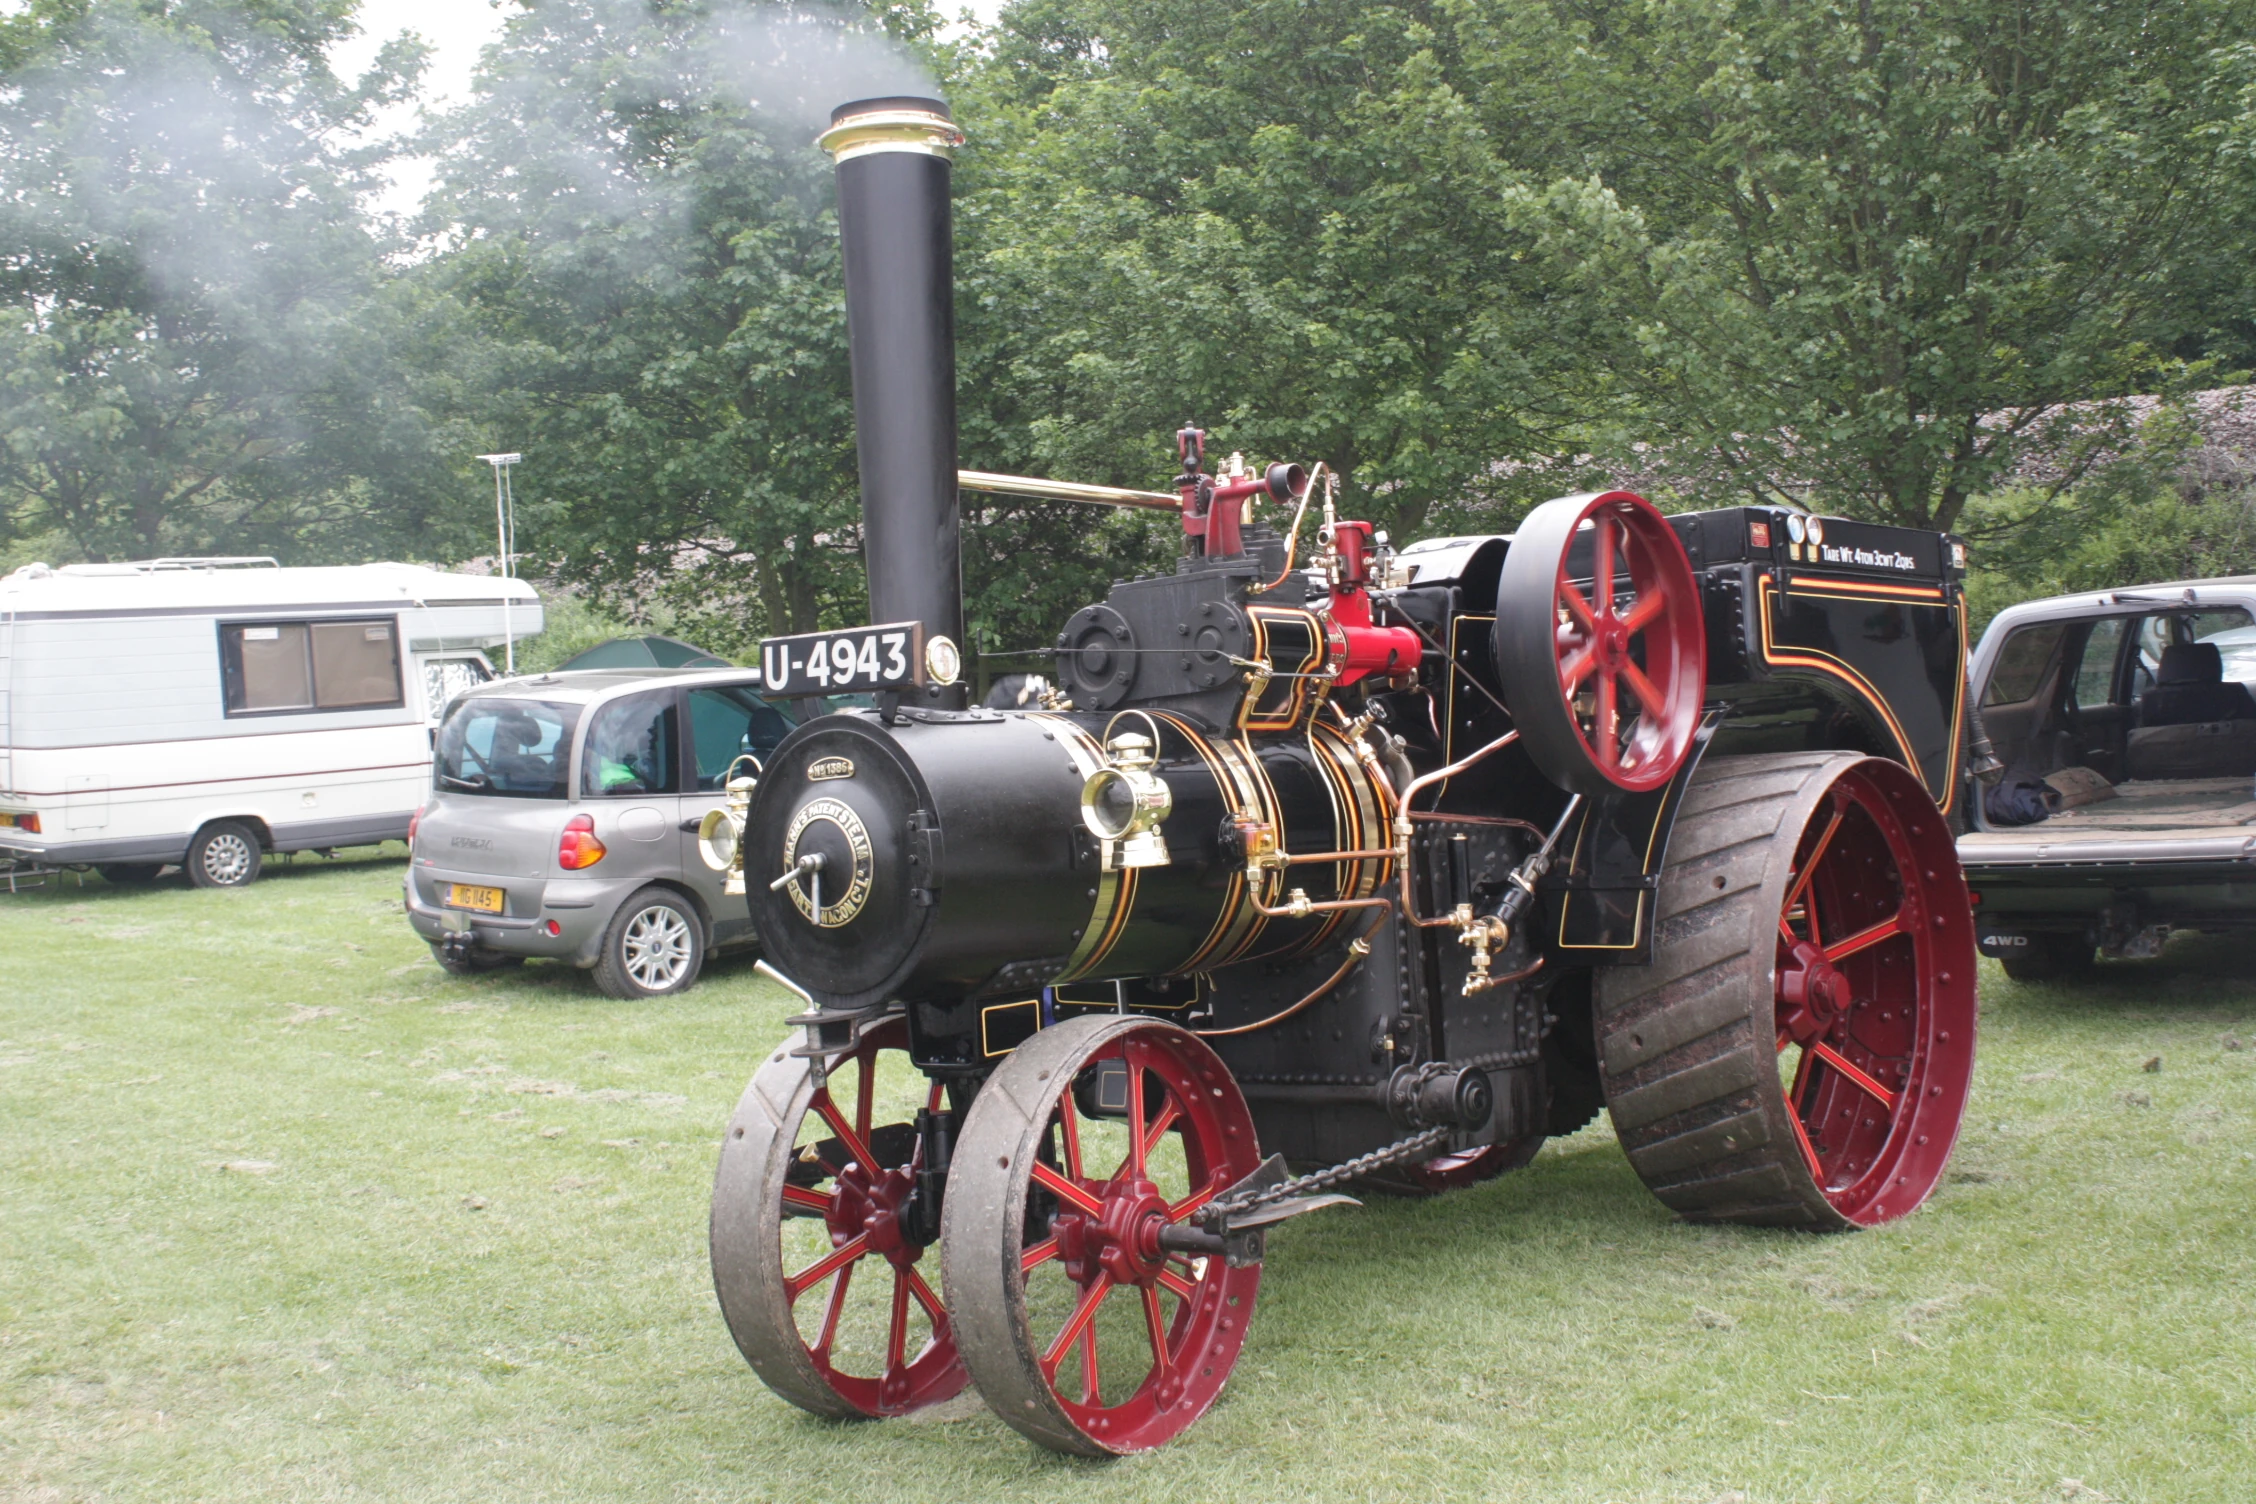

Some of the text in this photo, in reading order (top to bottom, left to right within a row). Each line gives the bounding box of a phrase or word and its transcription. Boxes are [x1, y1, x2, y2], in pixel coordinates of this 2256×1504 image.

[764, 632, 907, 691] U-4943
[826, 762, 848, 775] 1386
[784, 802, 869, 865] MANN'S PATENT STEAM
[1983, 935, 2028, 946] 4WD
